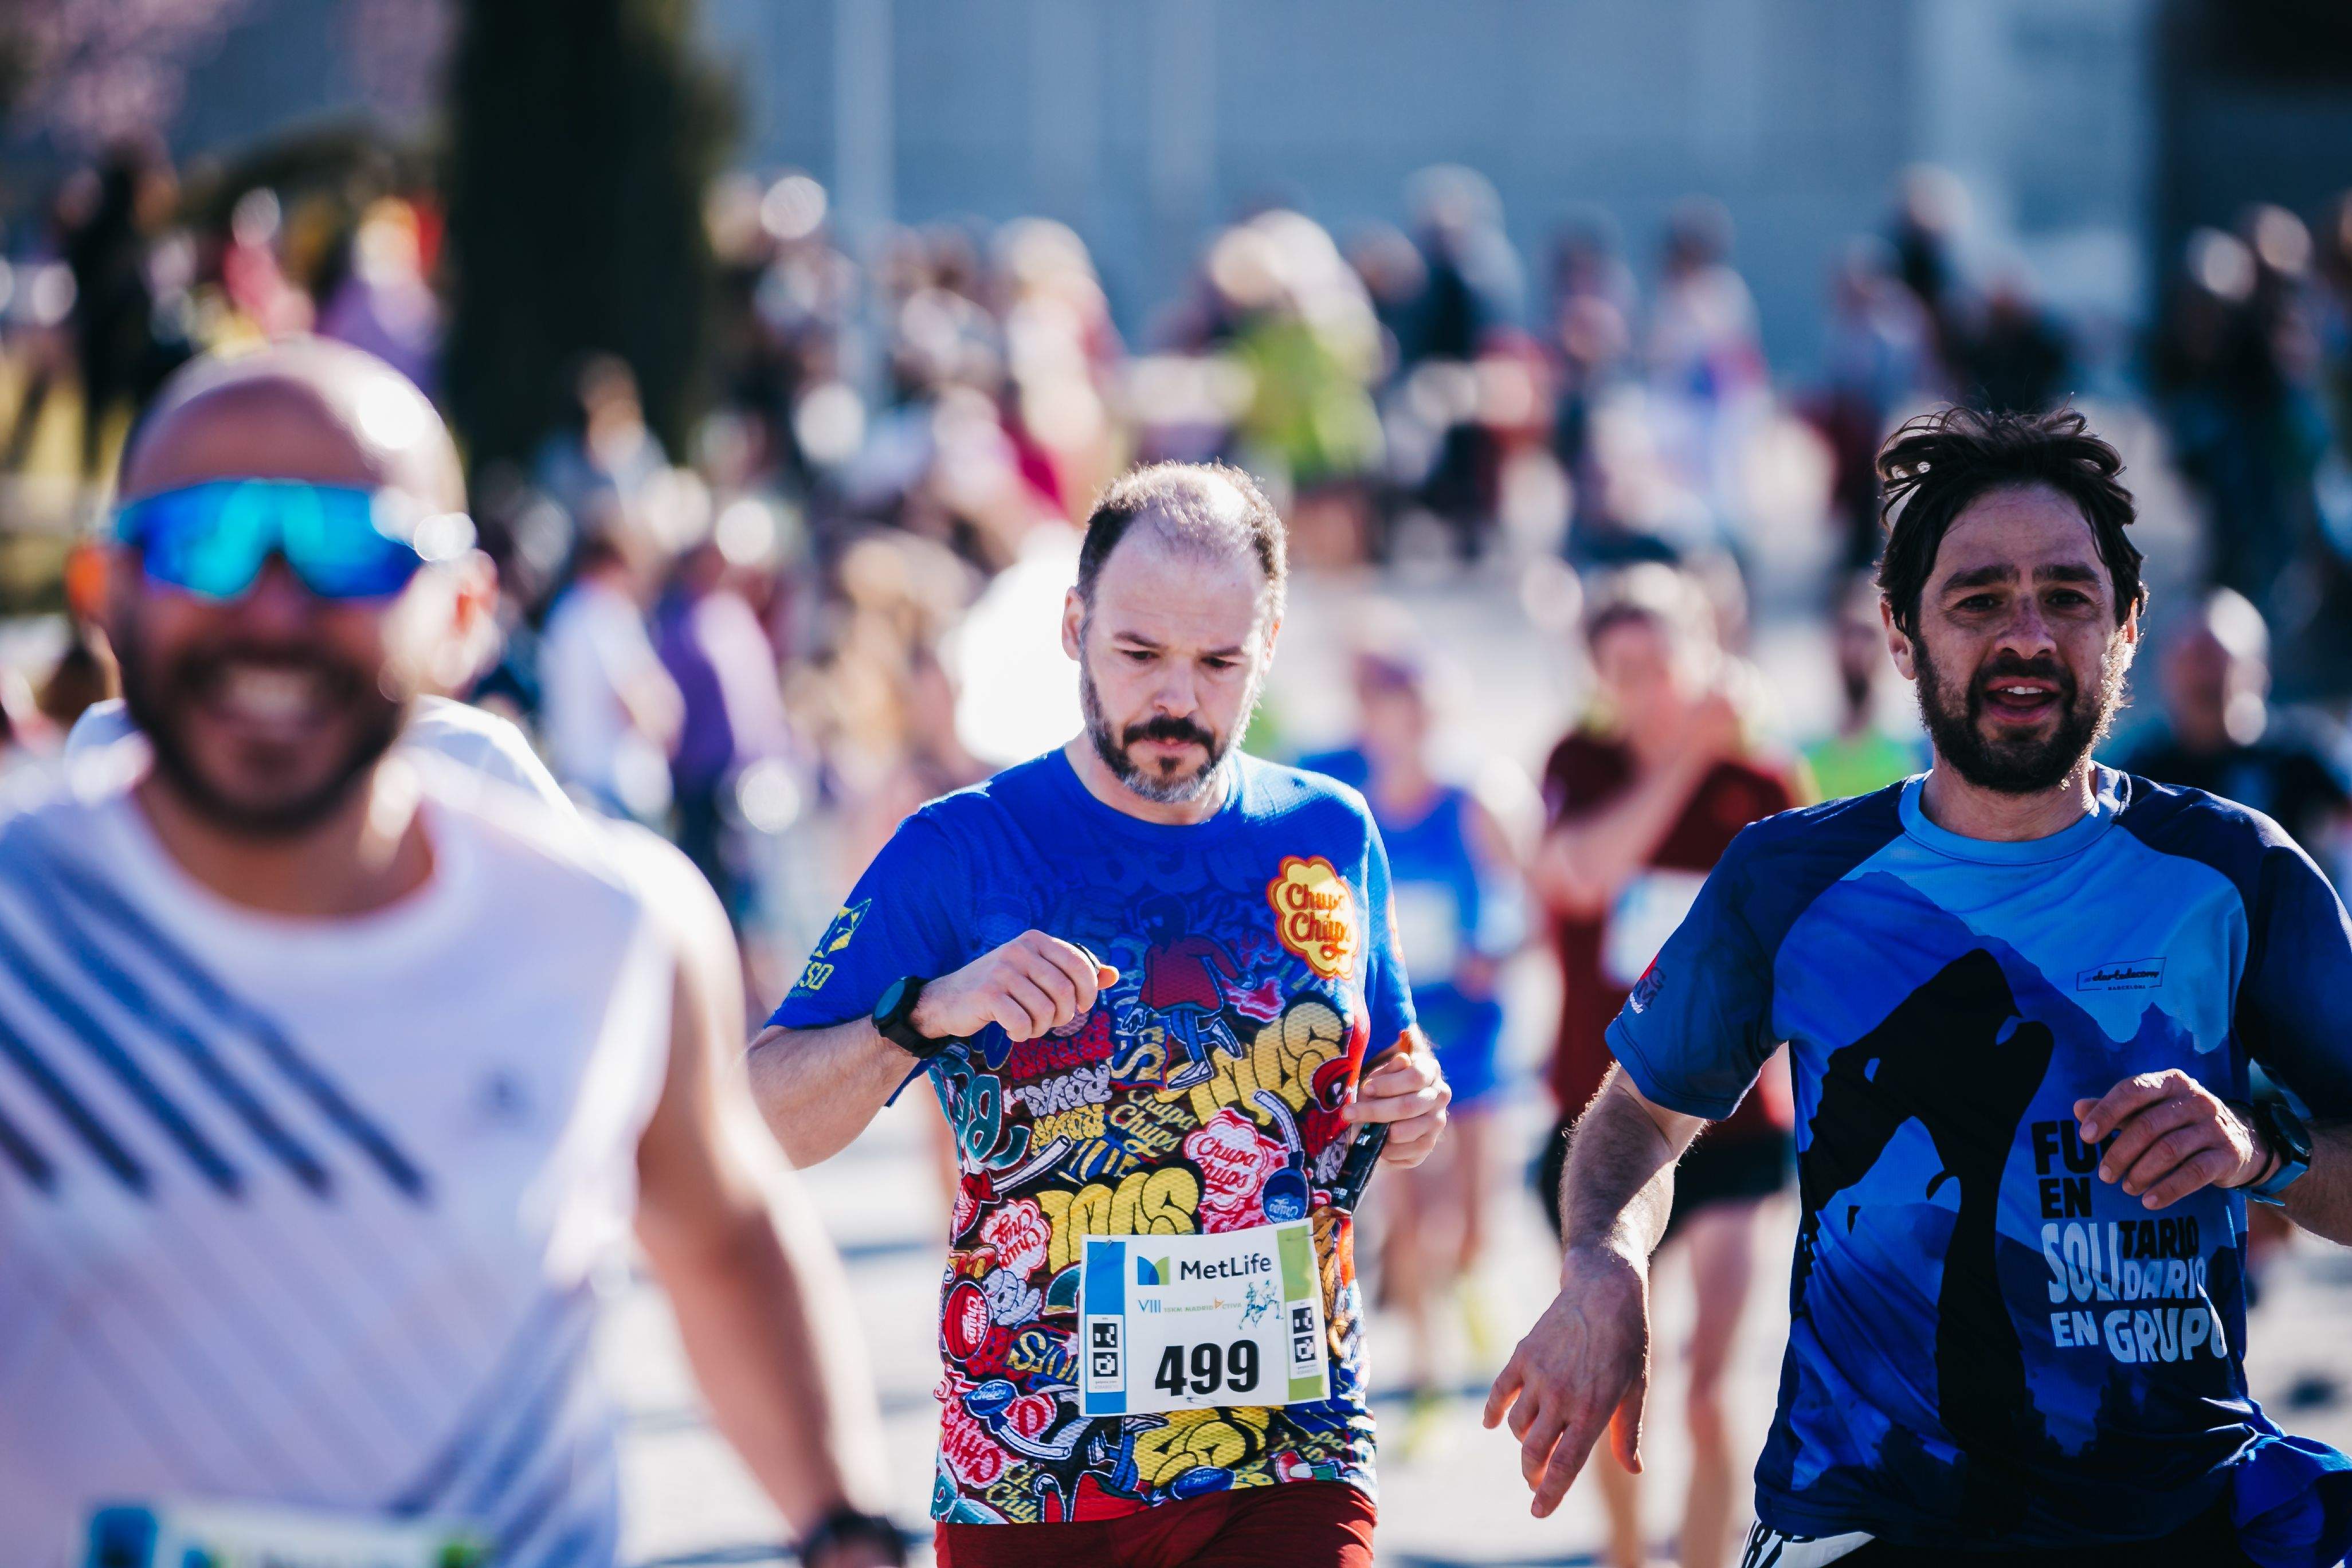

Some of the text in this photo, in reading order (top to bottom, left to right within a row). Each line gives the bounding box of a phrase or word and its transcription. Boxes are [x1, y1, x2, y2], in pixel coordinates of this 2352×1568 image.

[1110, 1104, 1182, 1154] Chups
[1197, 1136, 1258, 1167] Chupa
[2039, 1177, 2092, 1220] EN
[1180, 1252, 1272, 1281] MetLife
[1138, 1299, 1161, 1314] VIII
[2050, 1310, 2099, 1348] EN
[1154, 1339, 1260, 1397] 499
